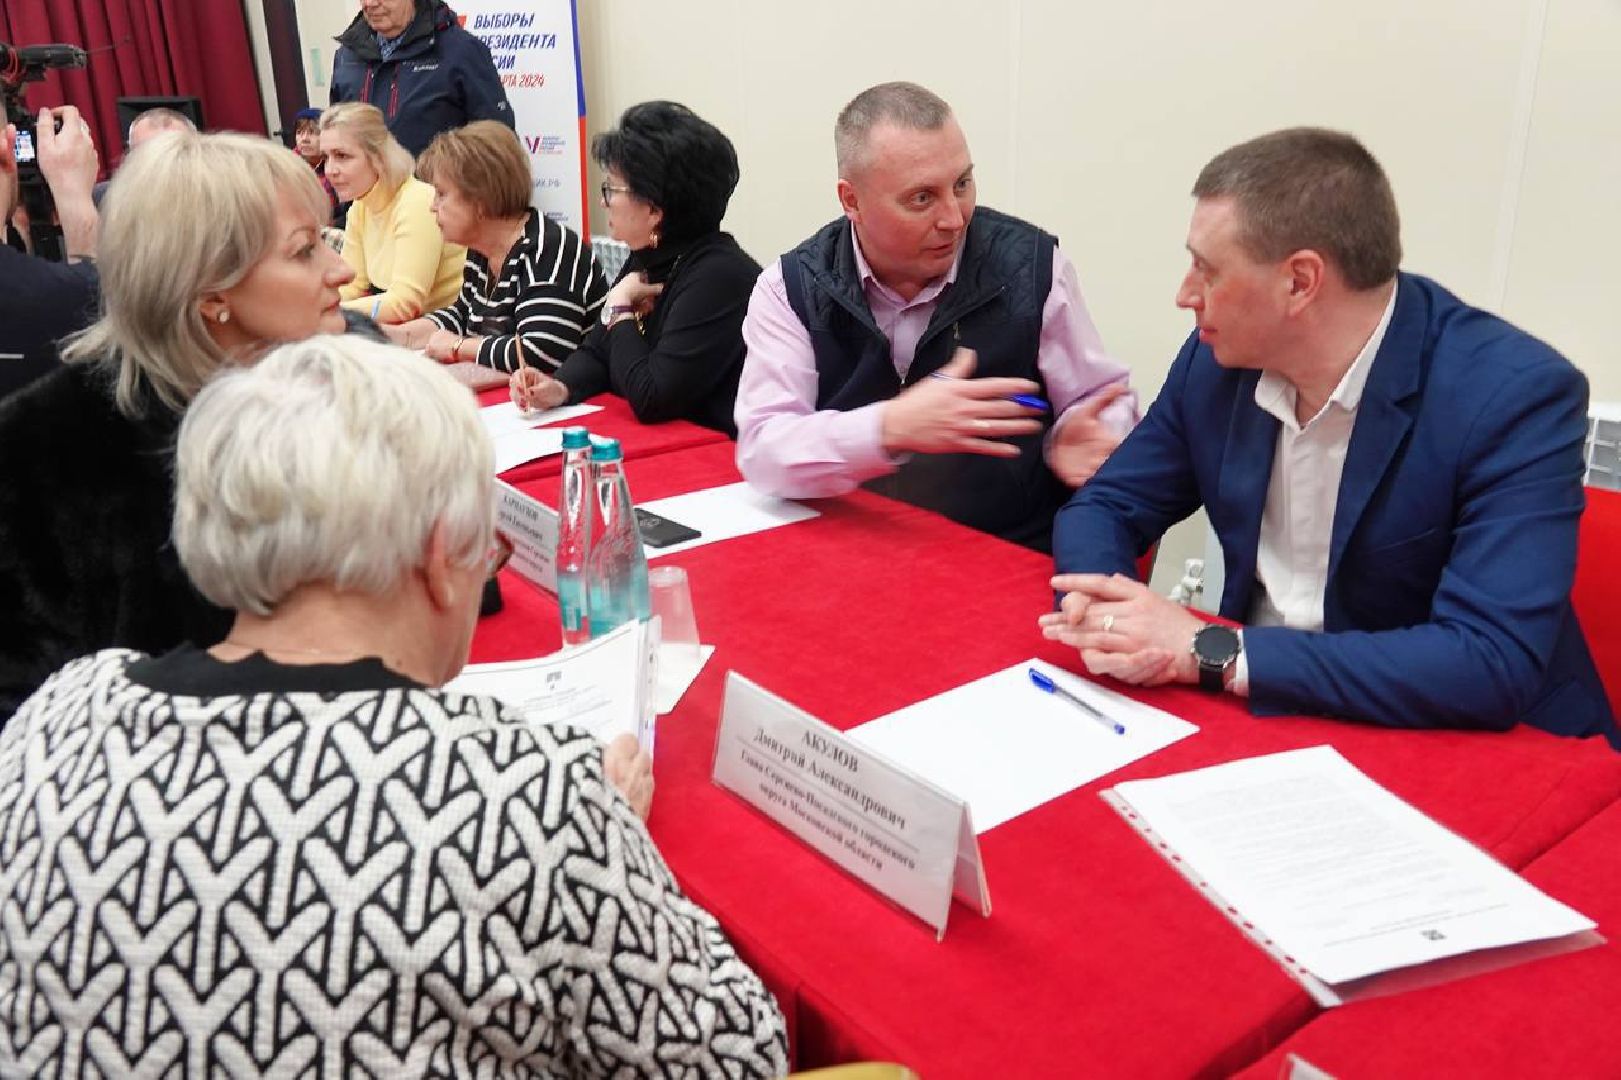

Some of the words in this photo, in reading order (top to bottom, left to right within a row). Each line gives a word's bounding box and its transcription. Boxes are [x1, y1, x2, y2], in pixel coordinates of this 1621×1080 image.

[474, 13, 535, 29] ВЫБОРЫ
[478, 34, 556, 50] РЕЗИДЕНТА
[519, 73, 544, 87] 2024
[801, 730, 858, 773] АКУЛОВ
[753, 729, 805, 768] Дмитрий
[807, 760, 905, 830] Александрович
